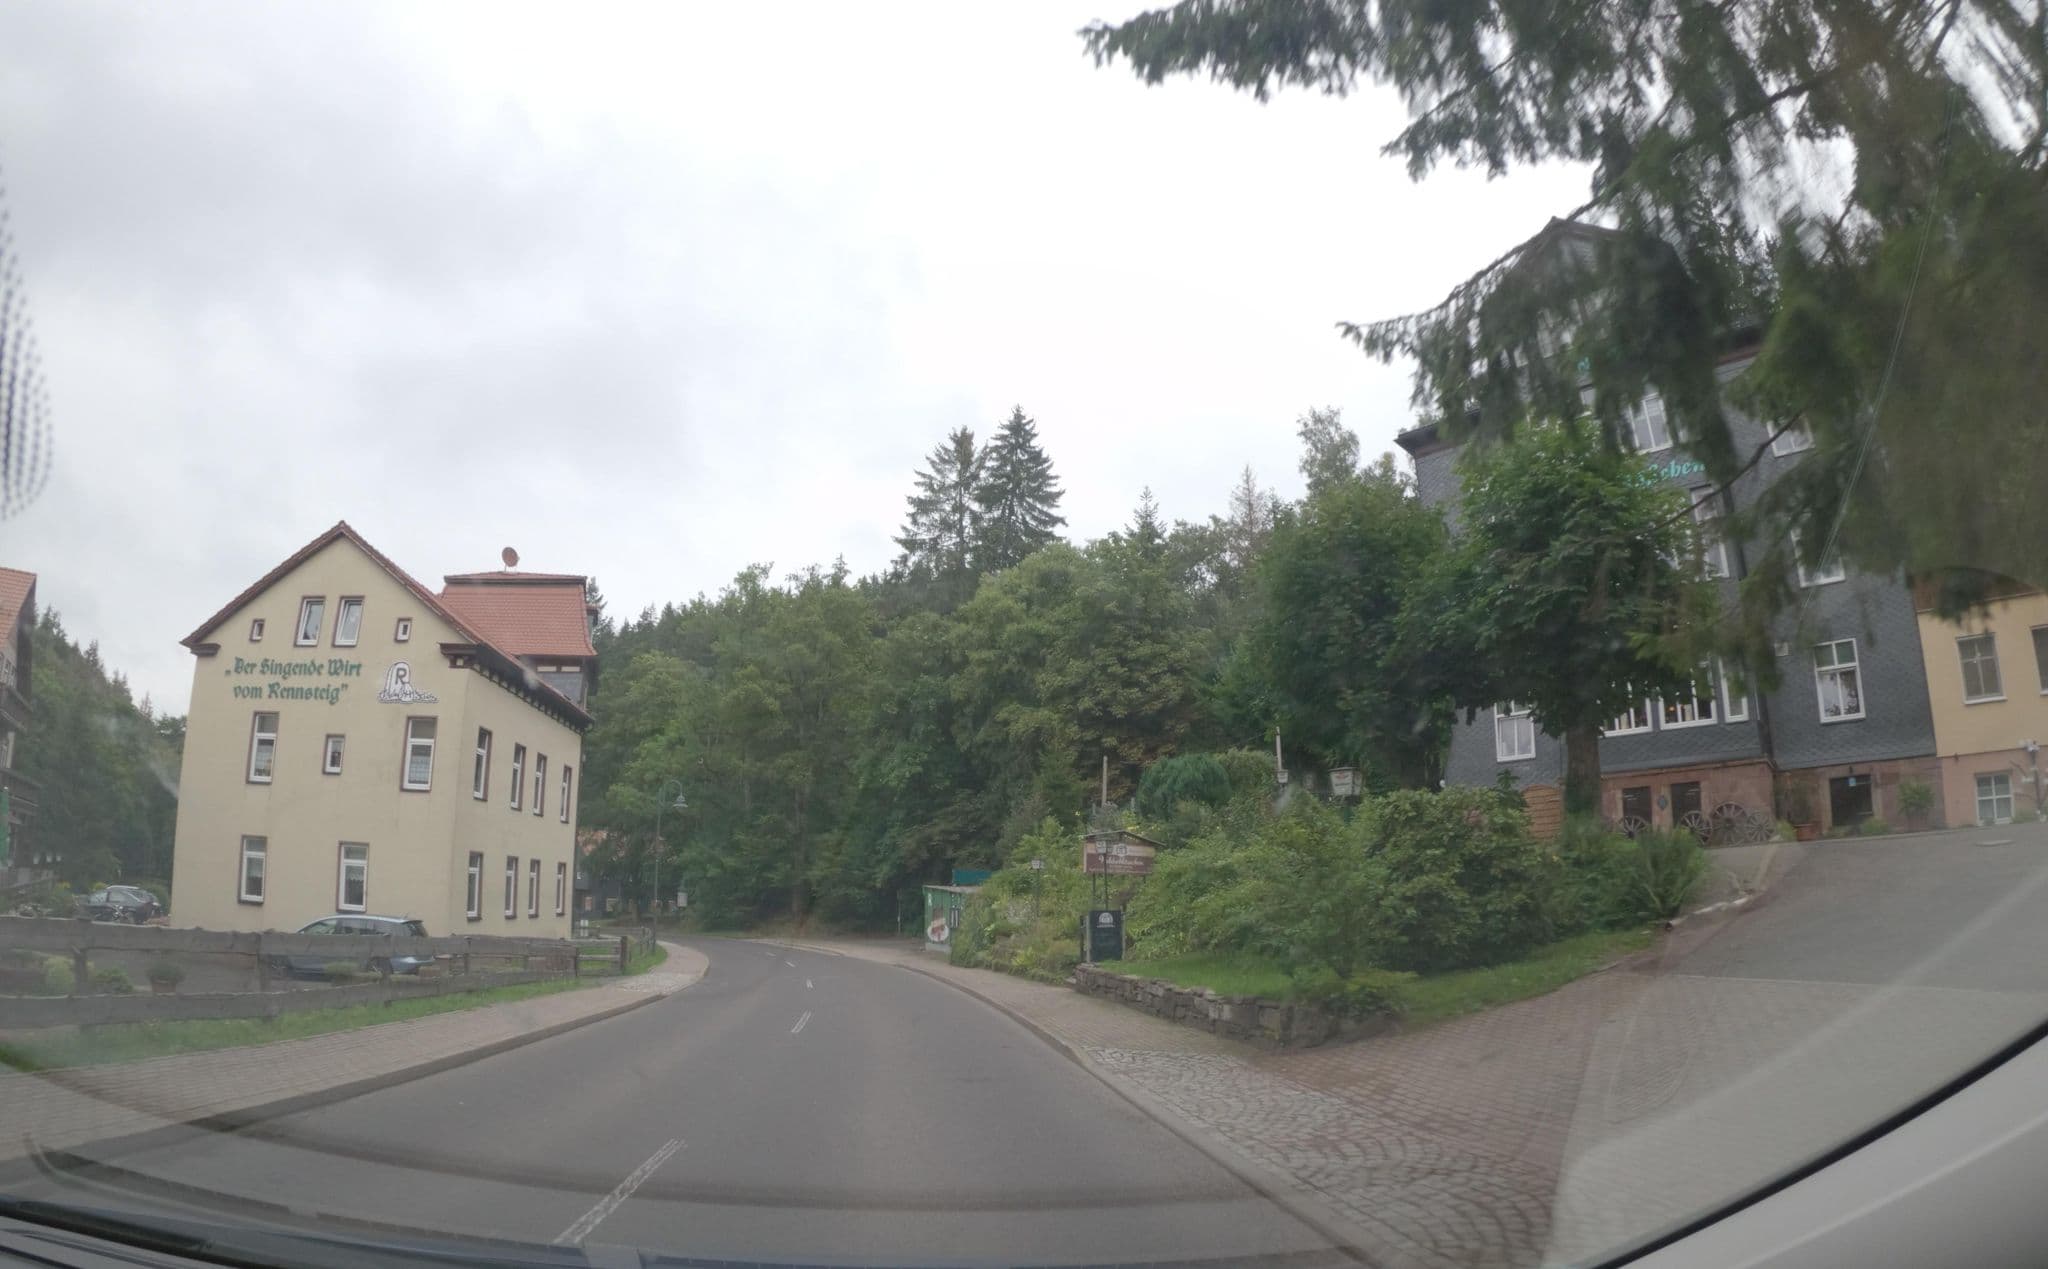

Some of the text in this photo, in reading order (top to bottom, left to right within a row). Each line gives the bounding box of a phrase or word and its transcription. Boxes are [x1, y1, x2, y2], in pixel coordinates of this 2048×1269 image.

[259, 658, 325, 680] Singende
[327, 658, 363, 677] Wirt
[232, 685, 263, 699] vom
